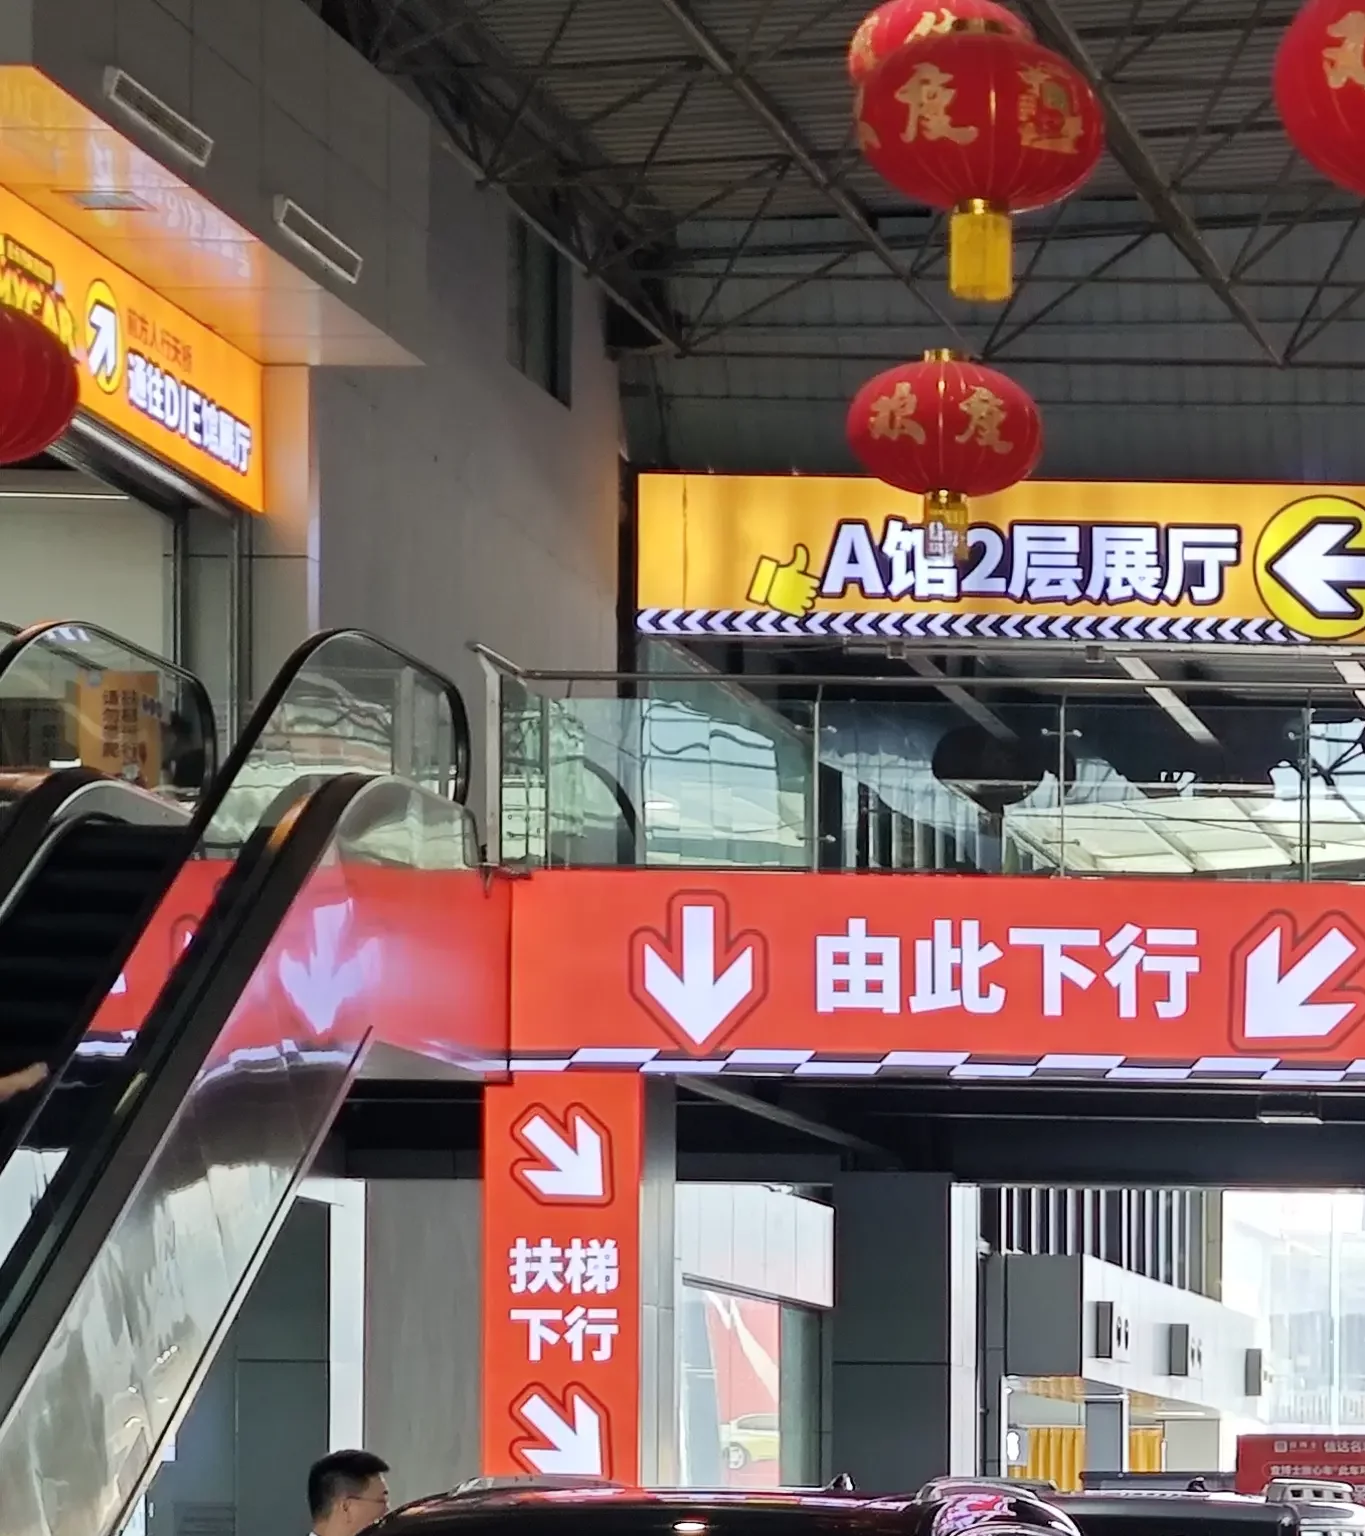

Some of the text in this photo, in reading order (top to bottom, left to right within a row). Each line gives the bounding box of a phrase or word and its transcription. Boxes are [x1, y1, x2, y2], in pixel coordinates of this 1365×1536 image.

[822, 515, 1243, 606] A馆2层展厅
[815, 917, 1201, 1019] 由此下行
[508, 1236, 620, 1296] 扶梯
[509, 1305, 620, 1363] 下行
